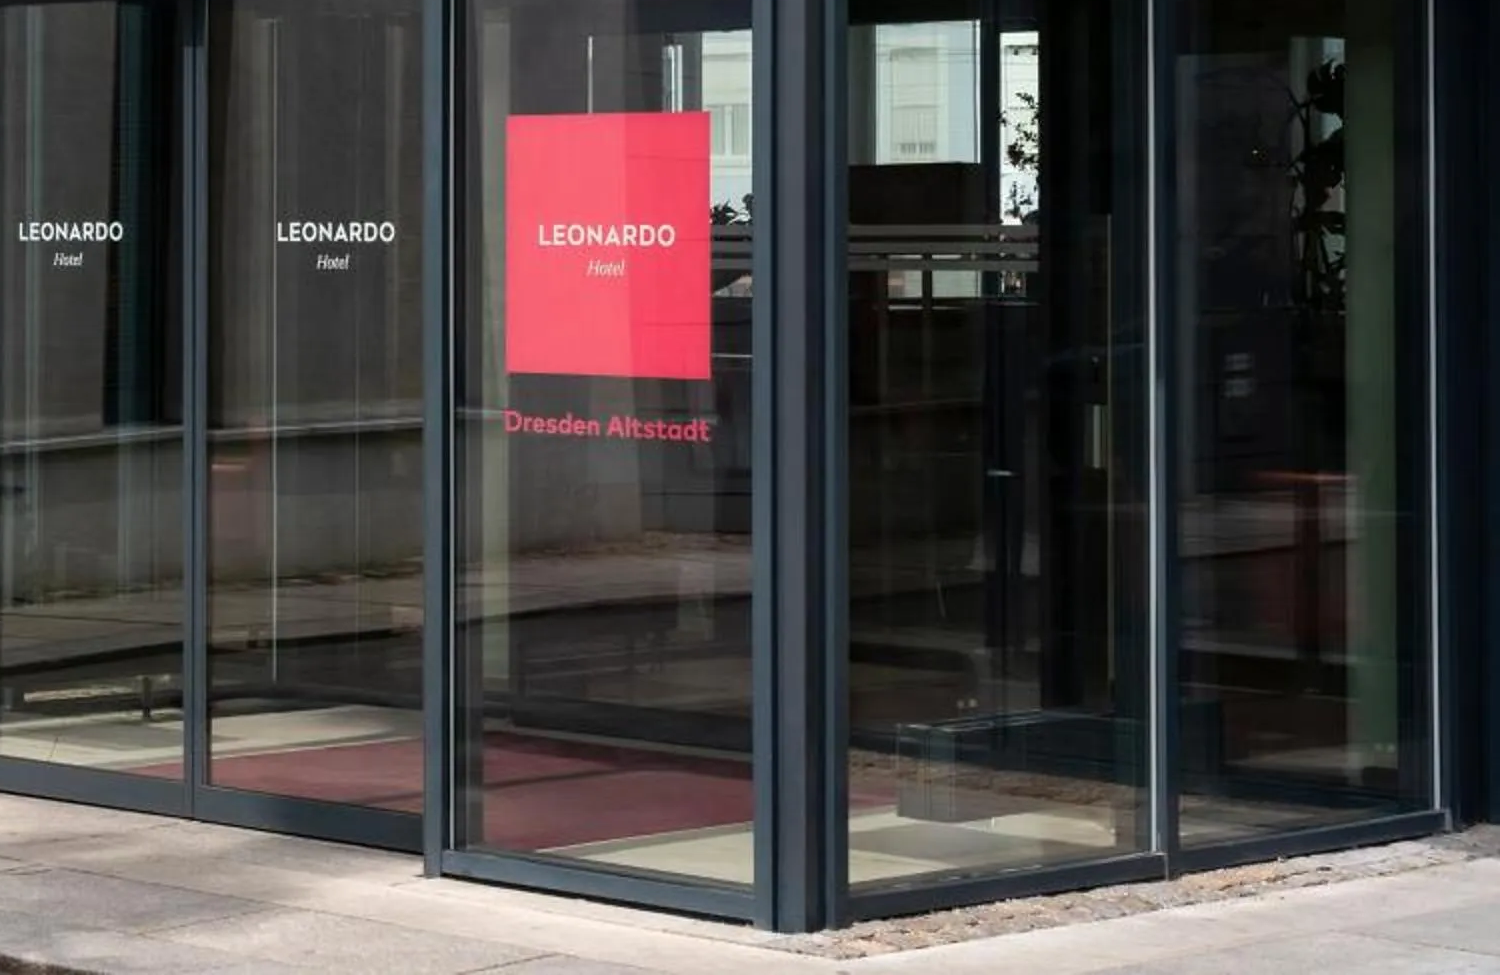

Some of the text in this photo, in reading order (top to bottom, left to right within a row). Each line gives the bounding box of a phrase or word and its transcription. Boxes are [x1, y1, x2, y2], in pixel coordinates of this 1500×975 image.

[18, 221, 124, 242] LEONARDO
[276, 222, 396, 243] LEONARDO
[538, 224, 676, 247] LEONARDO
[52, 251, 83, 267] Hotel
[316, 254, 350, 271] Hotel
[587, 258, 626, 277] Hotel
[504, 409, 712, 442] Dresden Altstadt
